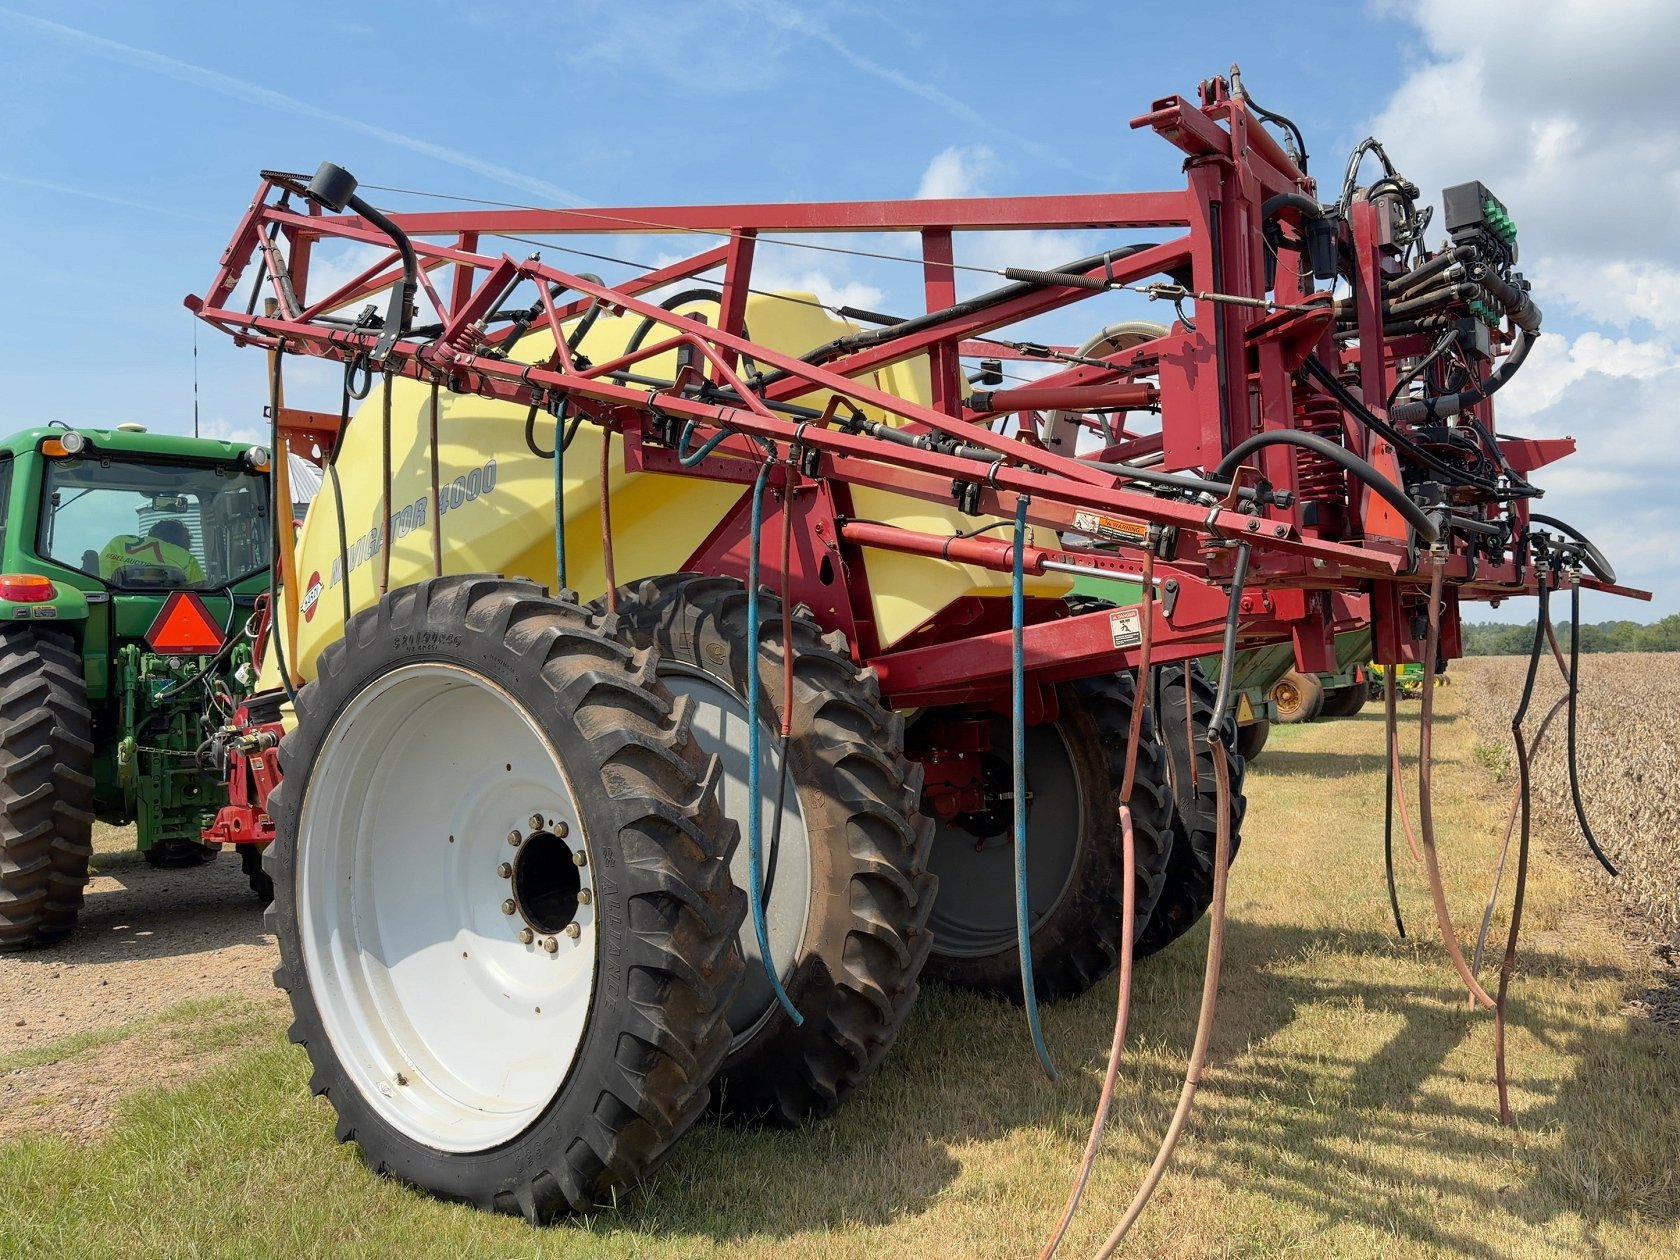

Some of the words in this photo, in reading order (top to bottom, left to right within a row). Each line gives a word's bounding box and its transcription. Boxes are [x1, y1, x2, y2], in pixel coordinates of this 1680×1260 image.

[330, 497, 428, 590] NVIGTOR
[439, 459, 497, 516] 4000
[1112, 522, 1141, 533] WARNING
[1117, 611, 1136, 619] DANGER
[600, 874, 622, 1014] ALLIANCE
